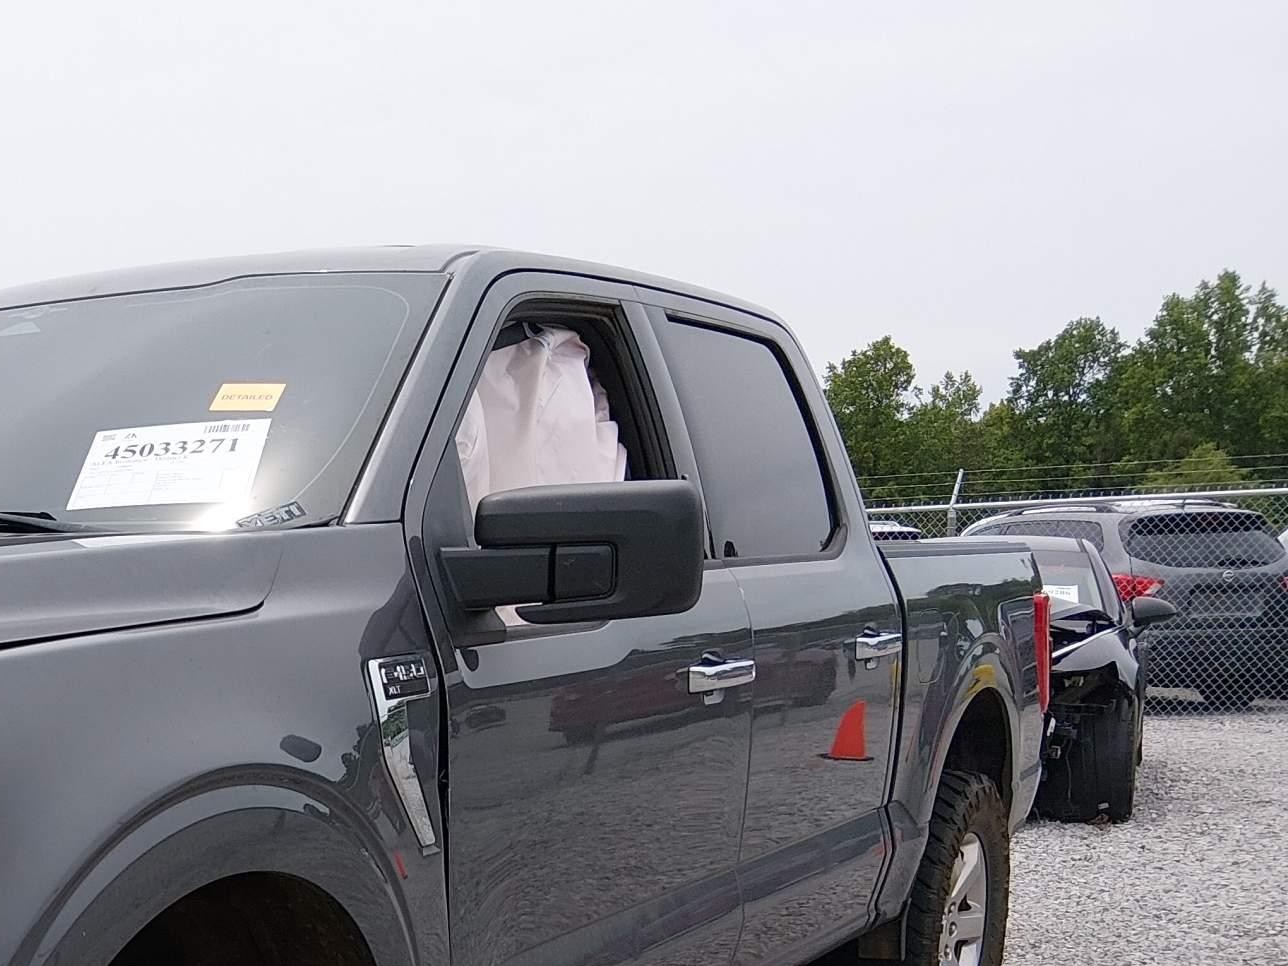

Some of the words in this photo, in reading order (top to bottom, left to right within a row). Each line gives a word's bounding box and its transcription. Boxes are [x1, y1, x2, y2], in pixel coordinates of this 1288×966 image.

[221, 393, 274, 401] DETAILED
[103, 438, 240, 460] 45033271
[388, 685, 401, 696] XLT
